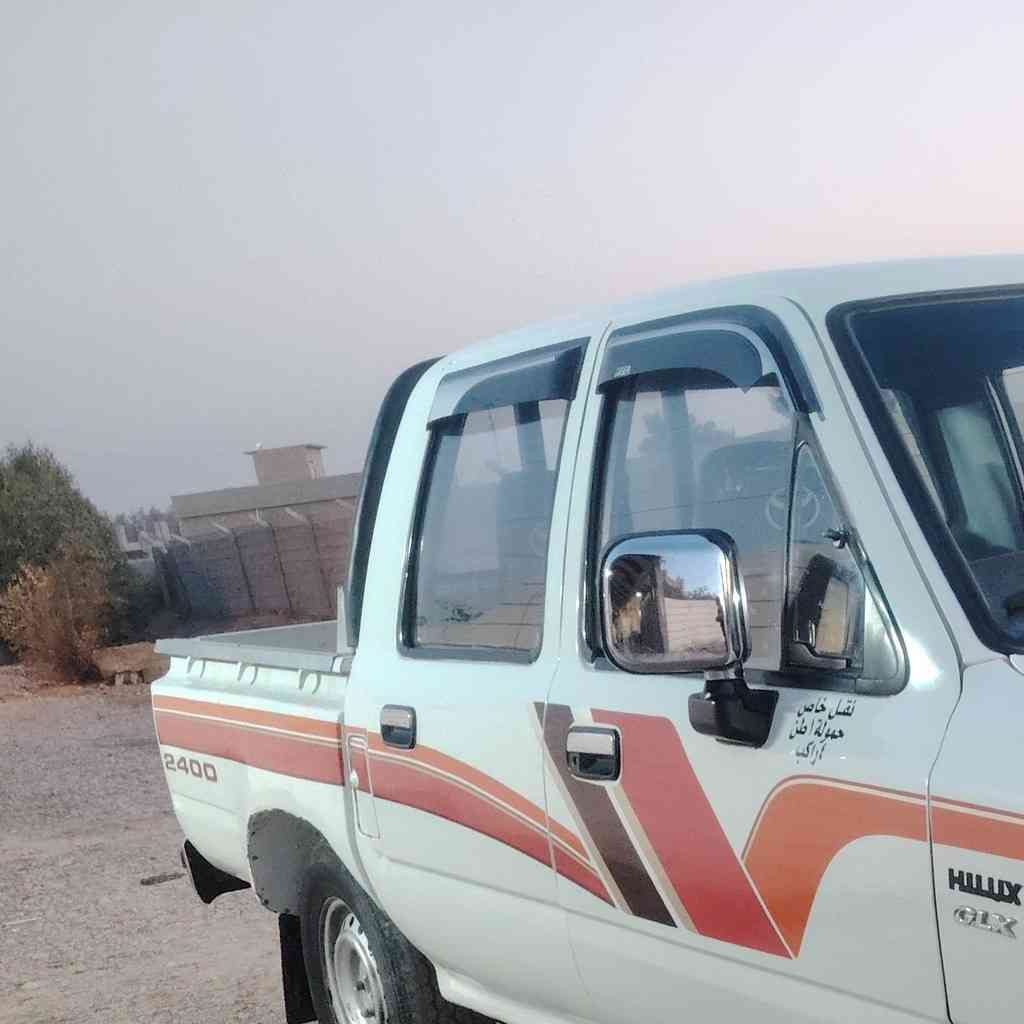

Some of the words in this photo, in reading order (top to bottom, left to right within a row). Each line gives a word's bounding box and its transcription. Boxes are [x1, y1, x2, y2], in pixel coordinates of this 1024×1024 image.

[796, 696, 827, 718] خاص
[828, 698, 857, 720] نقل
[814, 719, 844, 743] حمولة
[163, 752, 218, 783] 2400
[947, 866, 1024, 906] HILUX
[953, 905, 1018, 939] GLX
